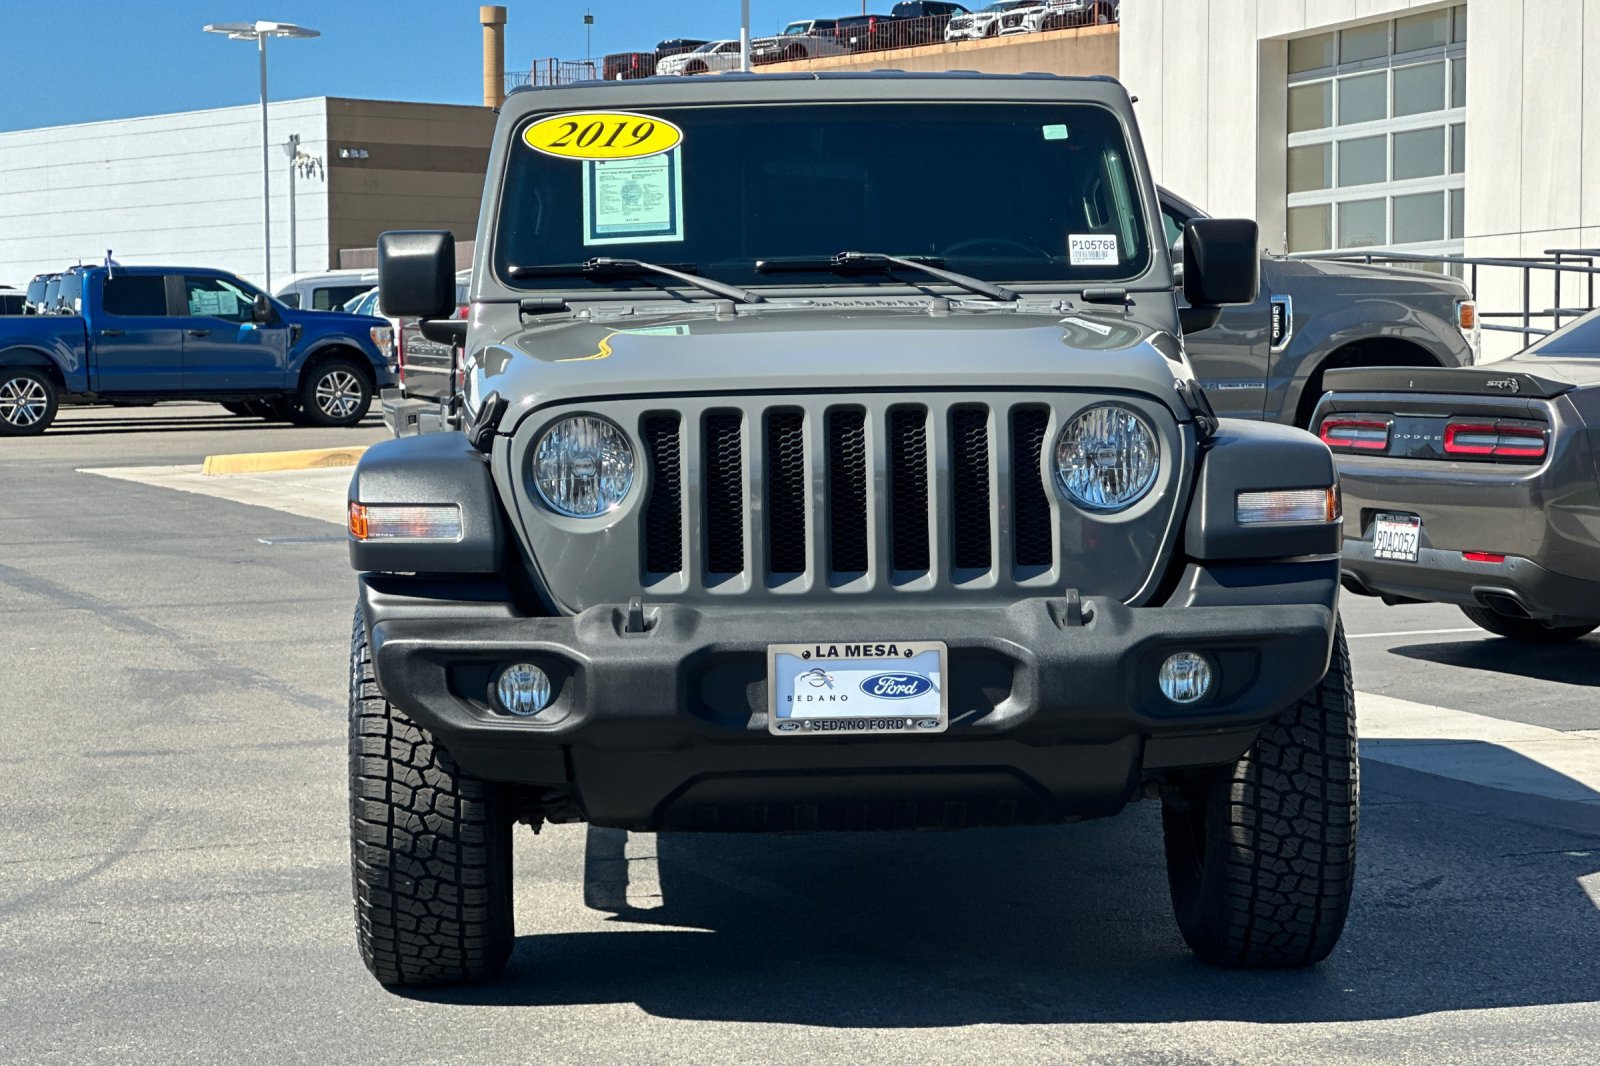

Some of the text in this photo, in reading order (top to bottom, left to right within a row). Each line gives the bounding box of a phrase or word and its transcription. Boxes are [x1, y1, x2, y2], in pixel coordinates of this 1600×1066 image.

[547, 121, 655, 148] 2019
[1072, 240, 1115, 250] P105768
[1486, 380, 1510, 389] SRT
[1394, 433, 1442, 441] DODGE
[1375, 530, 1416, 553] 9DAC052
[815, 644, 899, 658] LA MESA
[873, 676, 918, 695] Ford
[787, 694, 848, 702] SEDANO
[813, 718, 904, 731] SEDANO FORD
